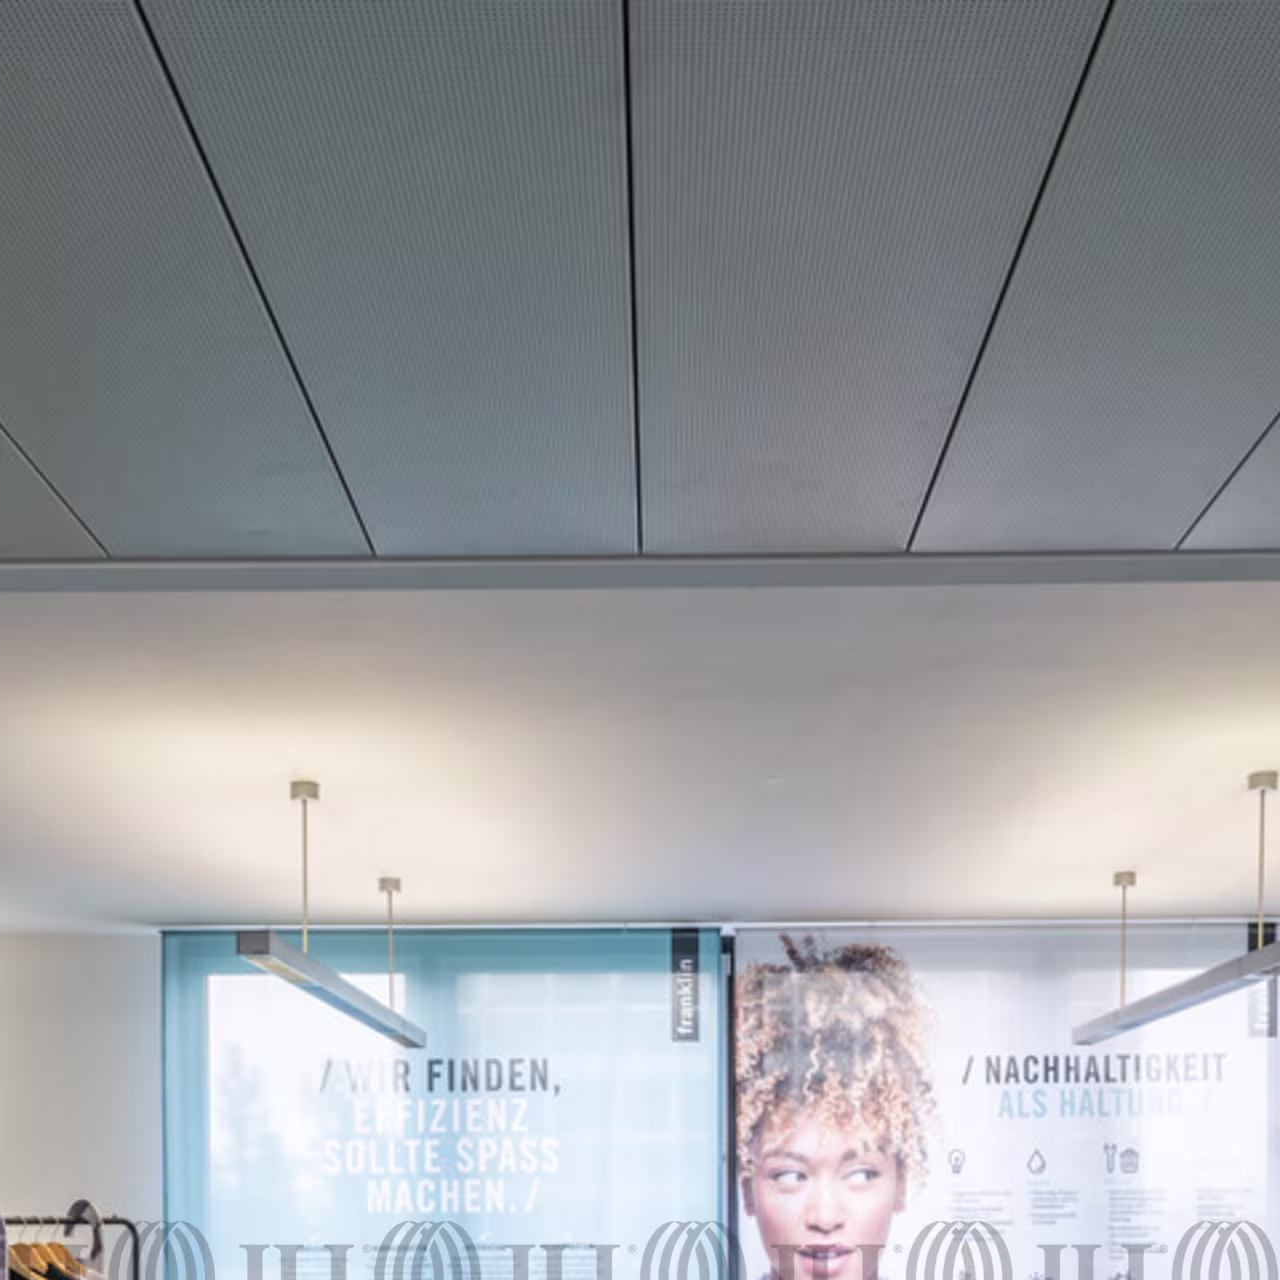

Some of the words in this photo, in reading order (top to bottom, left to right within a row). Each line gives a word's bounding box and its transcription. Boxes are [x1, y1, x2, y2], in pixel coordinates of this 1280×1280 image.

[678, 958, 694, 1034] franklin
[428, 1059, 563, 1097] FINDEN,
[985, 1053, 1227, 1085] NACHHALTIGKEIT
[355, 1098, 528, 1133] EFFIZIENZ
[998, 1088, 1047, 1119] ALS
[324, 1140, 441, 1173] SOLLTE
[458, 1139, 560, 1173] SPASS
[367, 1179, 516, 1213] MACHEN.
